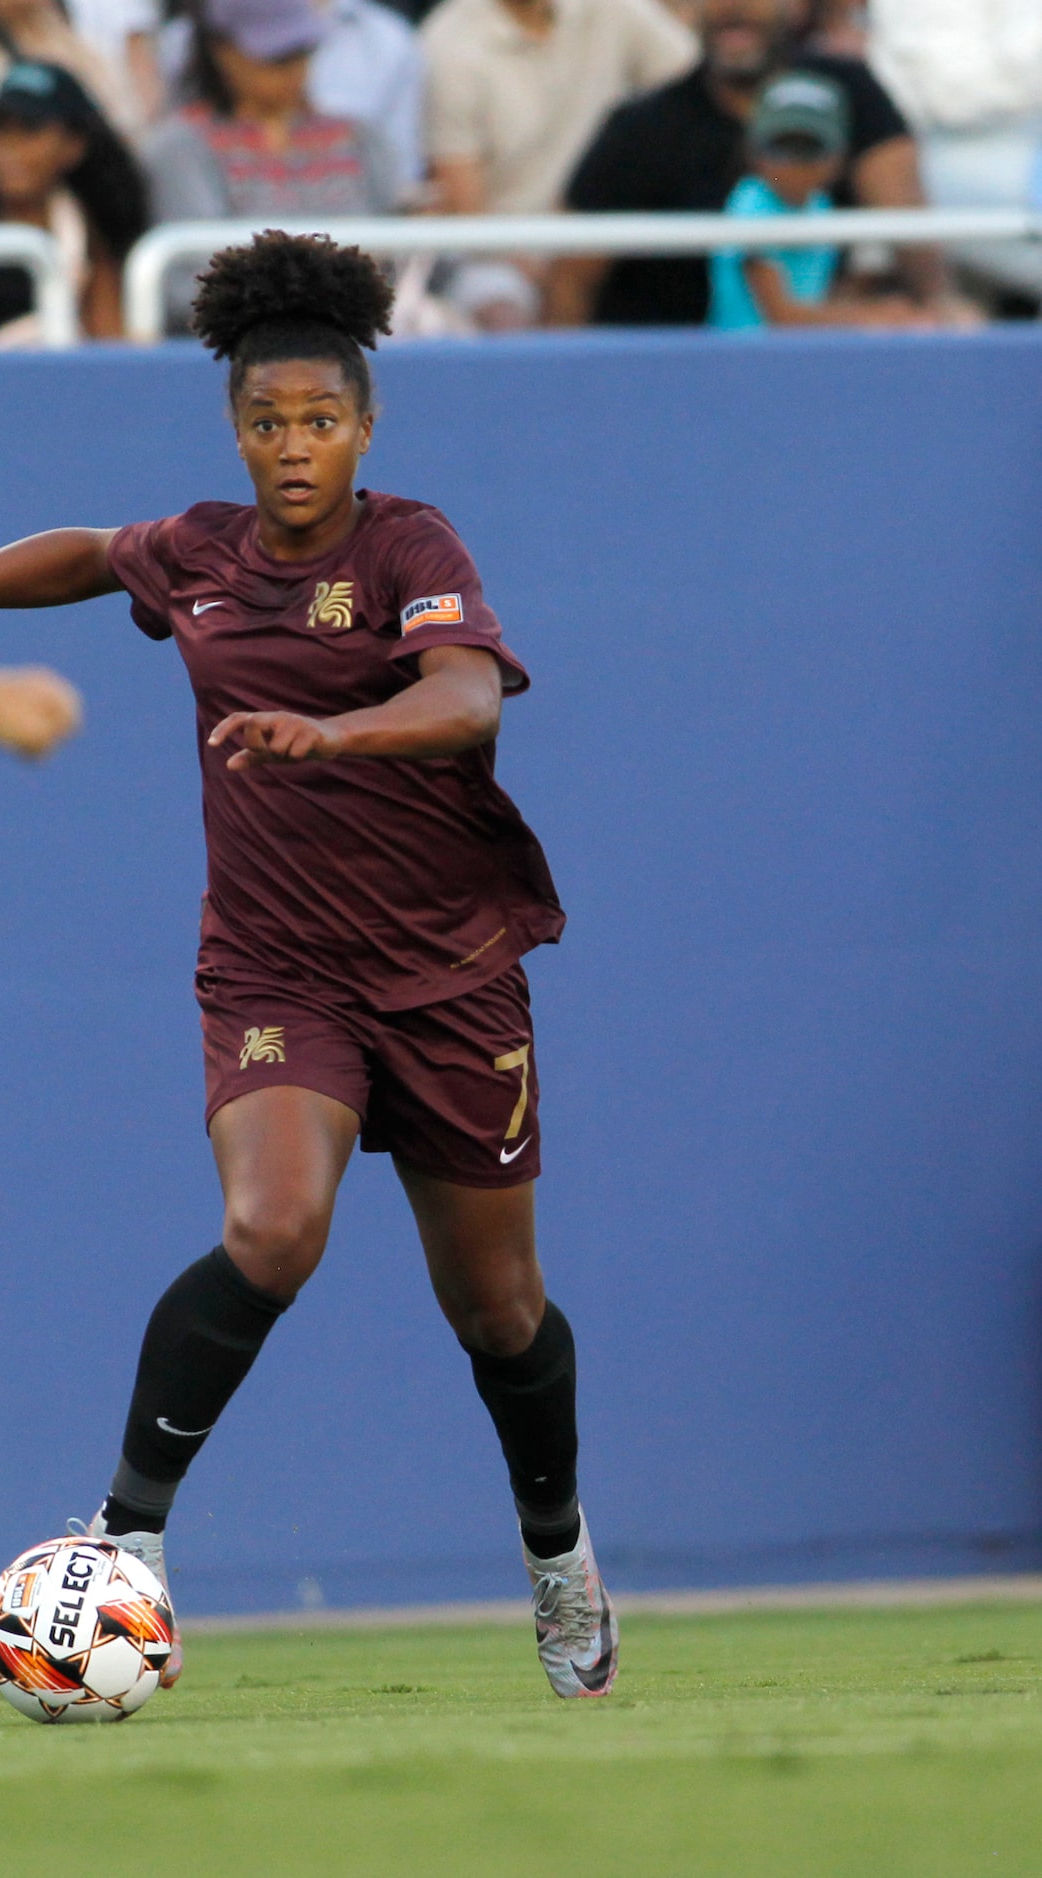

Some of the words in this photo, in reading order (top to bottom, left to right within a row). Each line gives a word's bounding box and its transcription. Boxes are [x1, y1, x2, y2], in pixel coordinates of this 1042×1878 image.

[405, 600, 439, 620] USL
[494, 1043, 530, 1140] 7
[49, 1551, 98, 1648] SELECT
